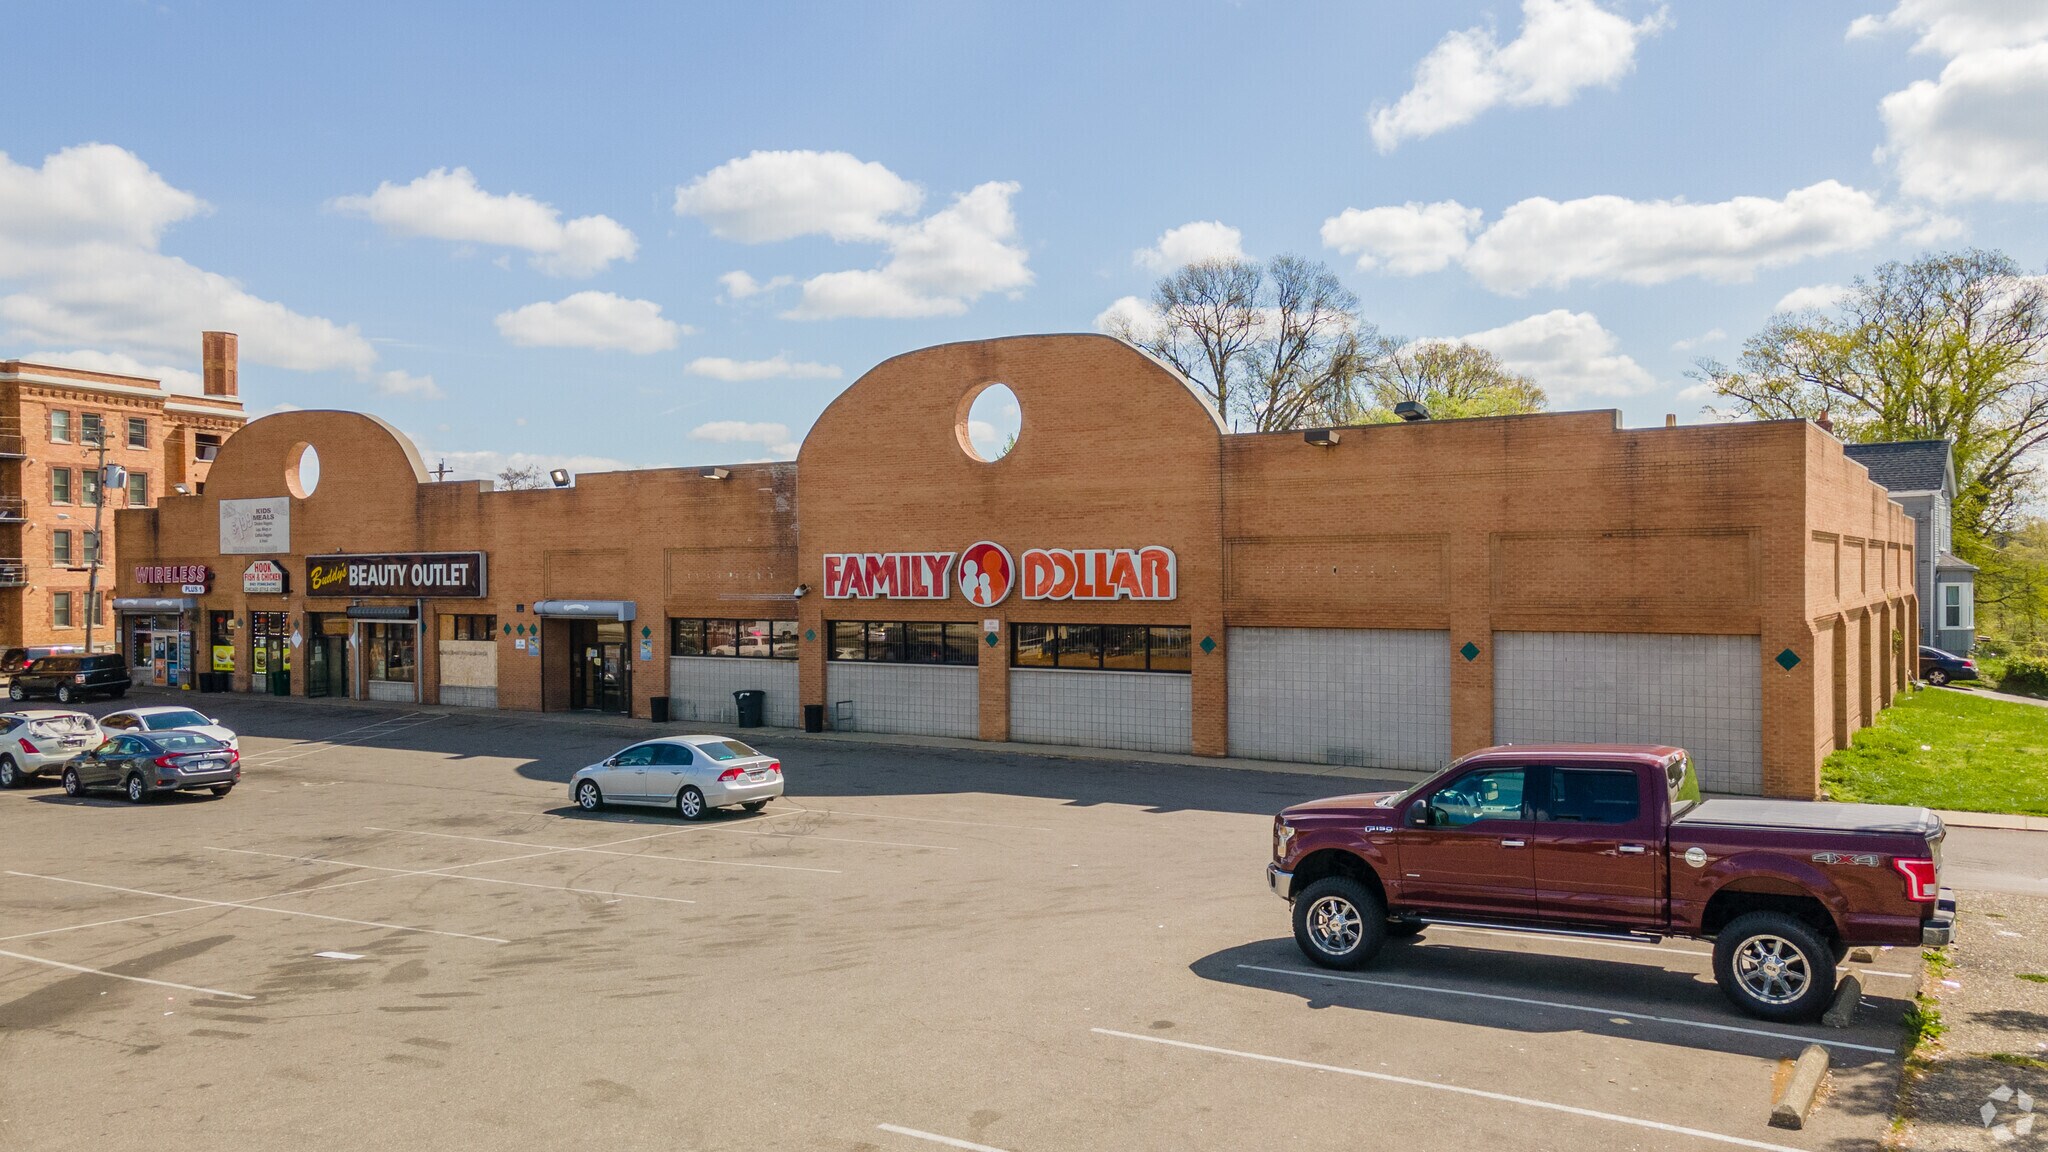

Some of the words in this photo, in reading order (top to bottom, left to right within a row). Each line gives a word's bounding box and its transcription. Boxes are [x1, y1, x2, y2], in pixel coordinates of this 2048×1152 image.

[135, 565, 206, 583] WIRELESS
[244, 573, 256, 581] FISH
[261, 573, 281, 581] CHICKEN
[254, 563, 272, 573] HOOK
[311, 562, 348, 590] Buddy's
[349, 564, 408, 586] BEAUTY
[411, 563, 469, 586] OUTLET
[823, 552, 955, 599] FAMILY
[1022, 547, 1174, 599] DOLLAR
